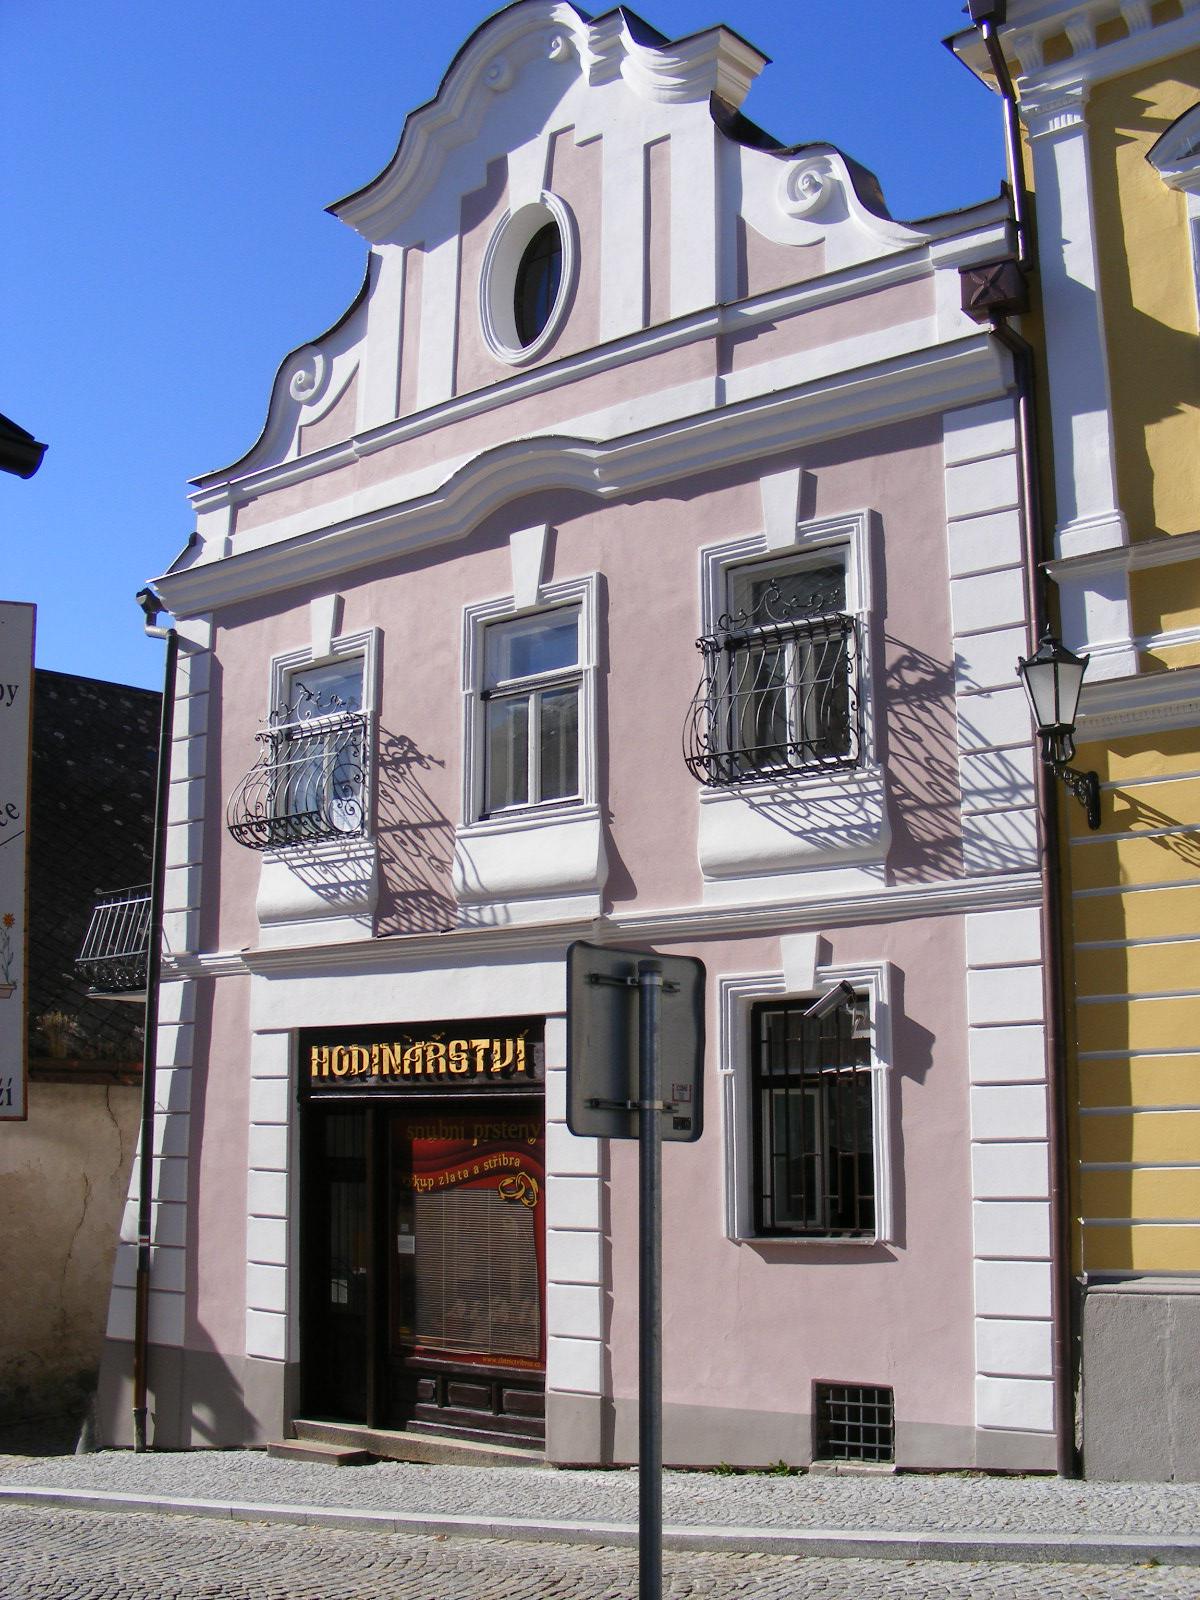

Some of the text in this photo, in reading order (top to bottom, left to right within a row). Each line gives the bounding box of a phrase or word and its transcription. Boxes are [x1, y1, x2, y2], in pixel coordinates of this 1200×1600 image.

[472, 1119, 541, 1146] prsteny
[439, 1168, 469, 1186] zlata
[473, 1164, 480, 1174] a
